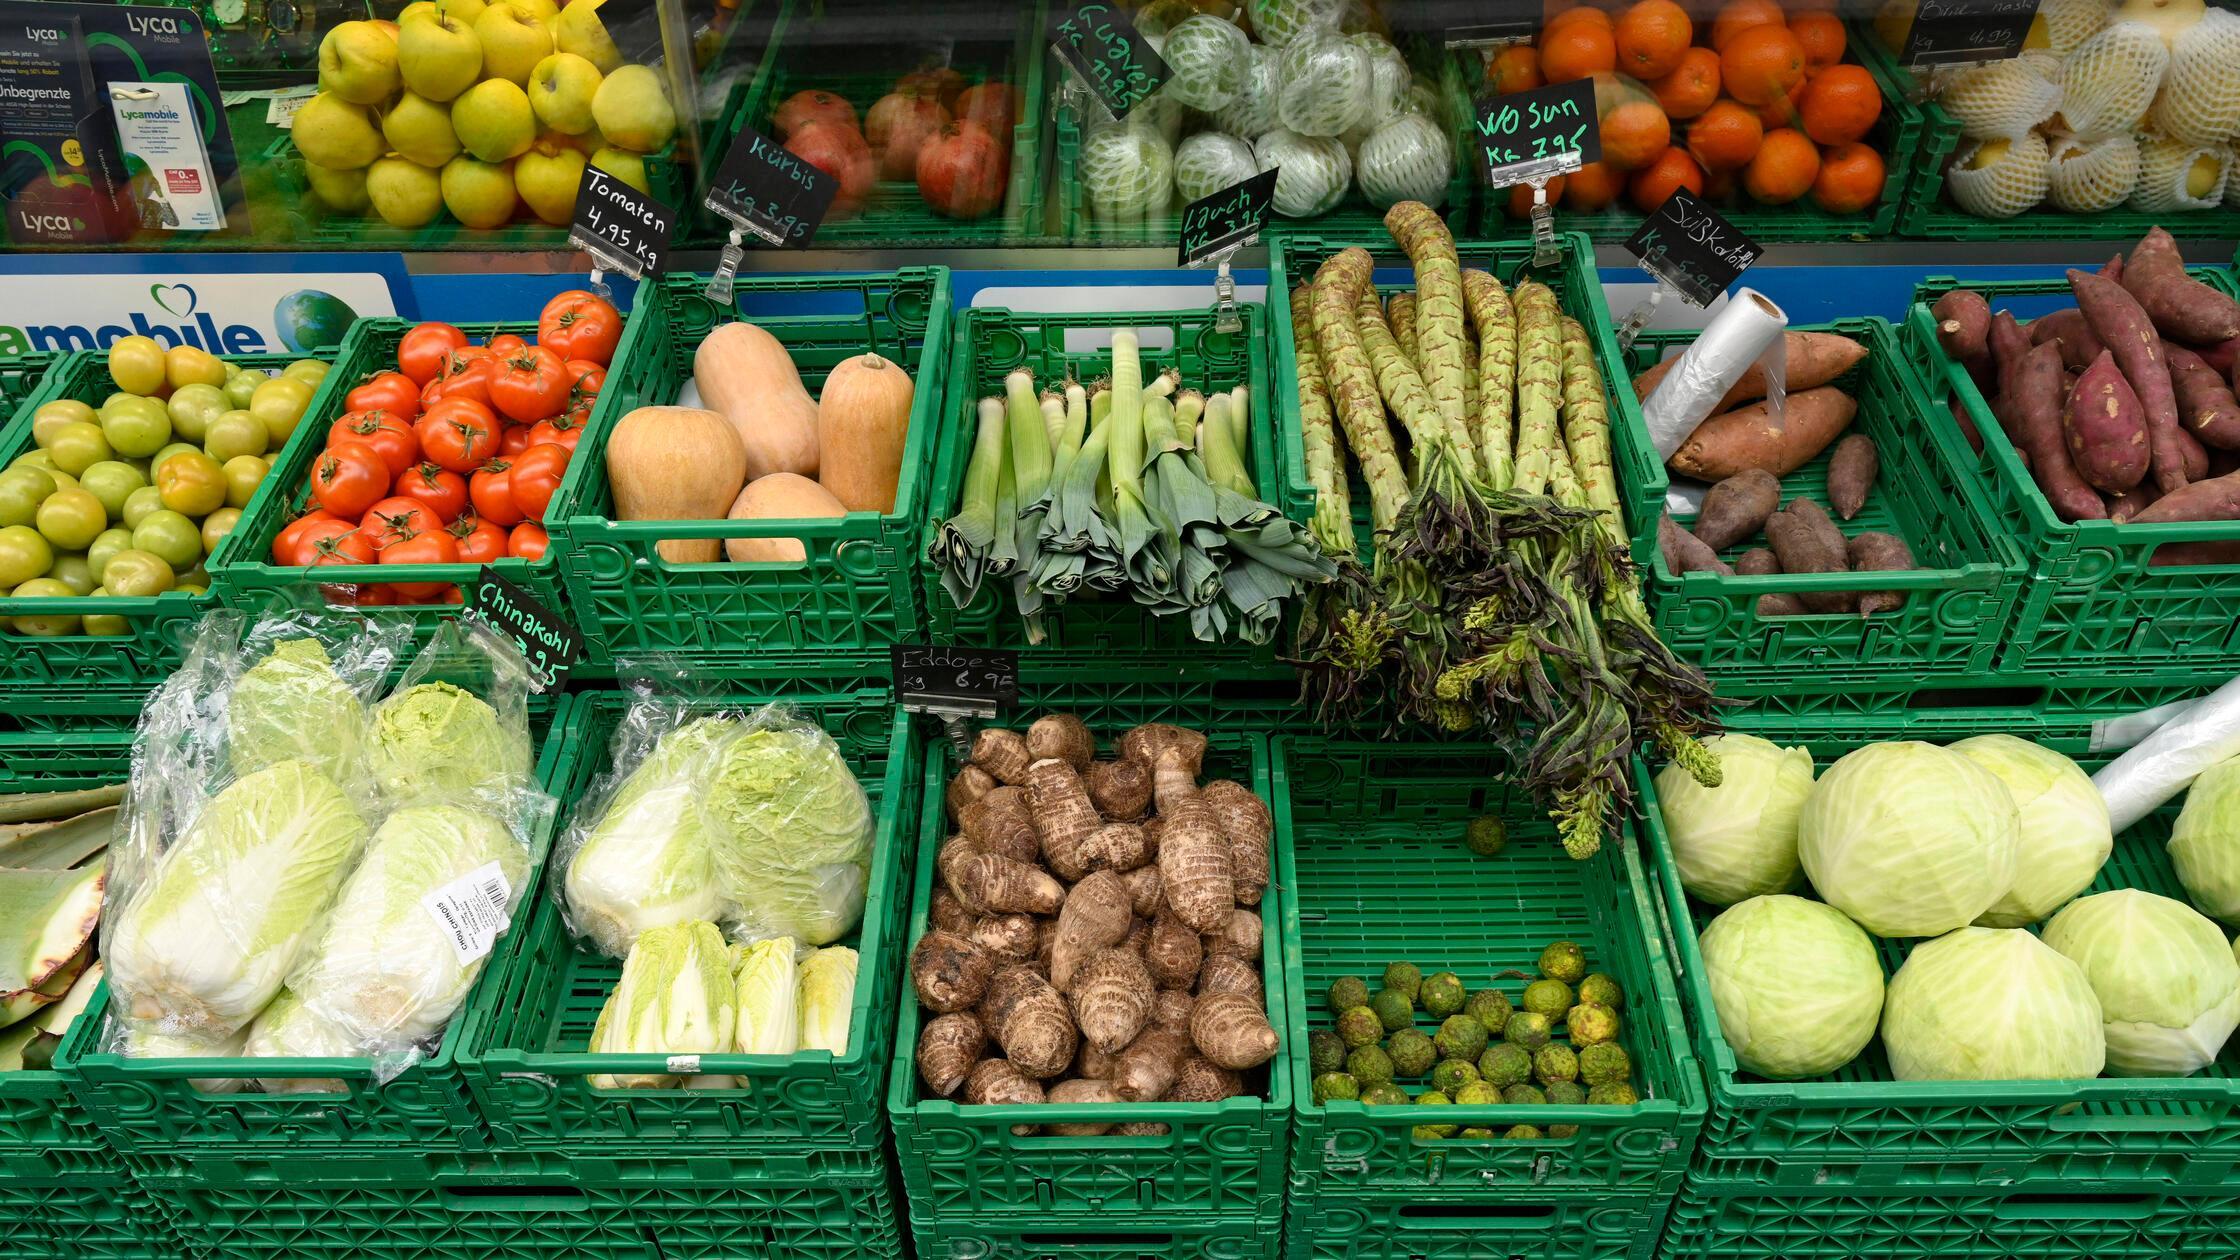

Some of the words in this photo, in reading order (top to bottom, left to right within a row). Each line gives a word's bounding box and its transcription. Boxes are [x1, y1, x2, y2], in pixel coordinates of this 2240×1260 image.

[26, 26, 58, 42] Lyca
[126, 12, 178, 36] Lyca
[153, 34, 181, 44] Mobile
[1078, 5, 1159, 94] Guaves
[120, 109, 179, 120] Lycamobile
[749, 136, 816, 191] Kürbis
[587, 168, 665, 234] Tomaten
[1184, 189, 1250, 234] Lauch
[21, 210, 71, 233] Lyca
[588, 205, 632, 247] 4,95
[47, 231, 73, 240] Mobile
[480, 583, 571, 658] Chinakohl
[902, 648, 1011, 671] Eddoes
[436, 901, 458, 930] CHINOIS
[455, 929, 468, 951] CHOU
